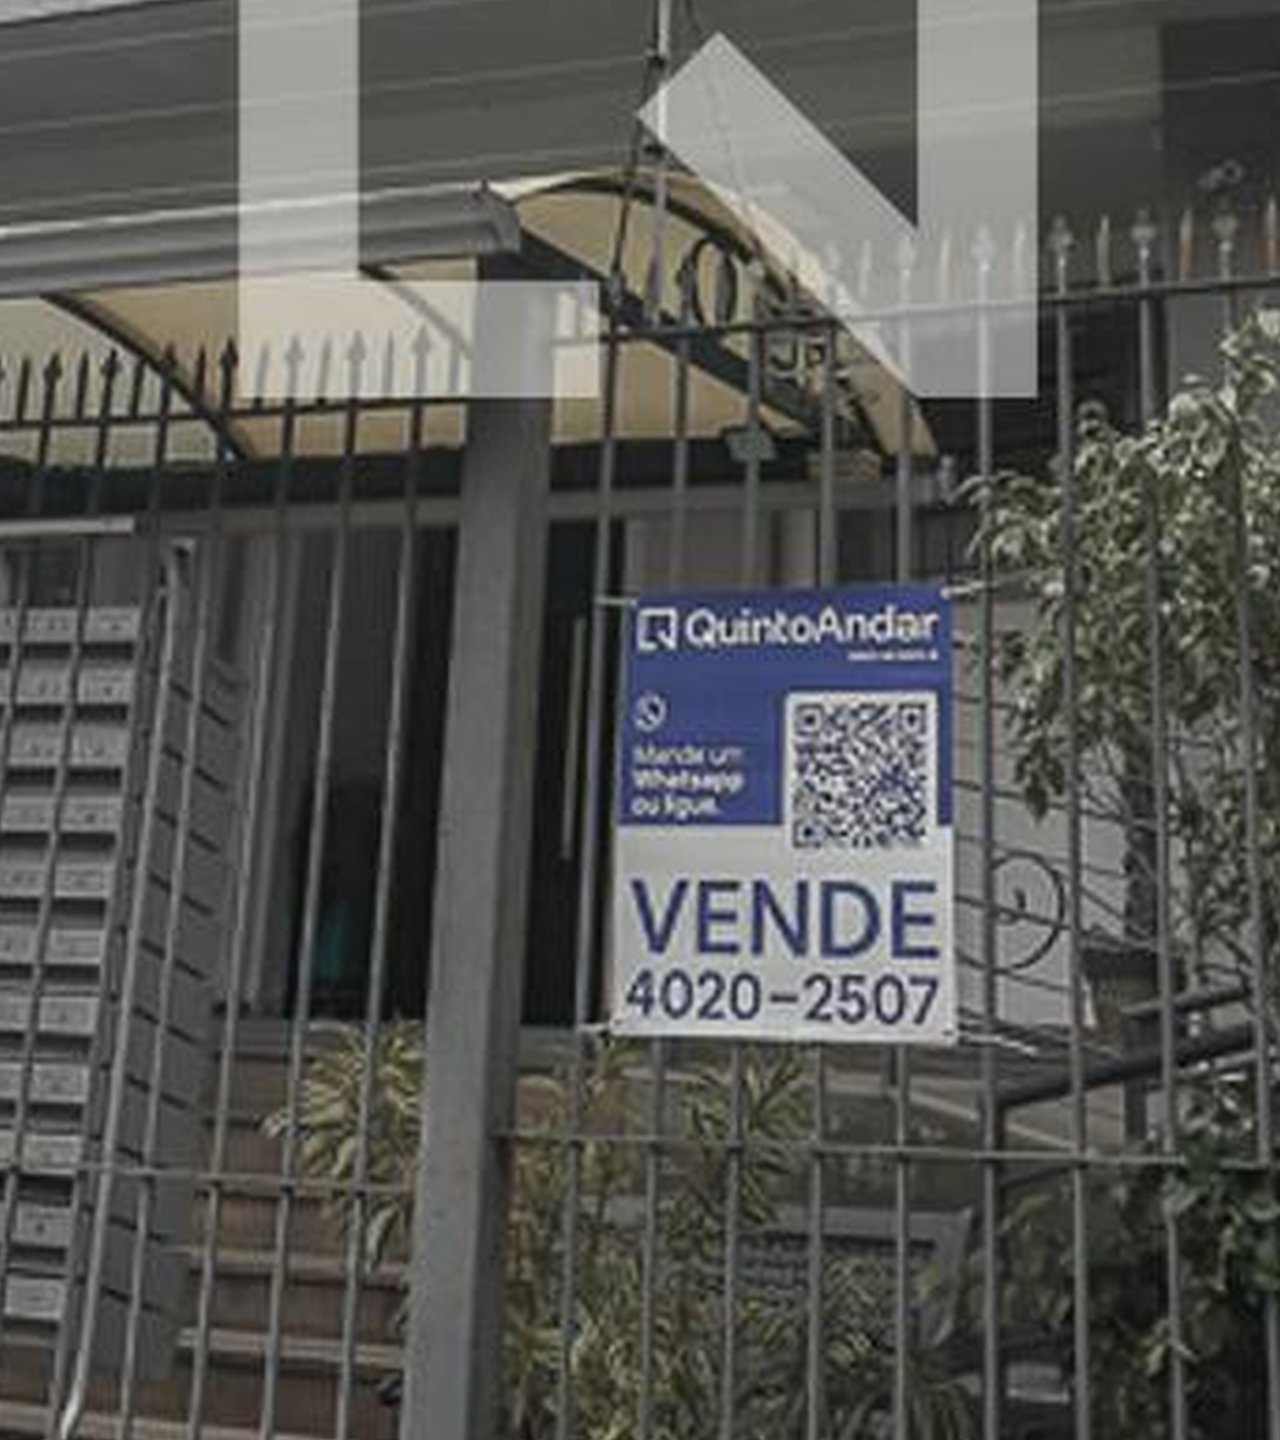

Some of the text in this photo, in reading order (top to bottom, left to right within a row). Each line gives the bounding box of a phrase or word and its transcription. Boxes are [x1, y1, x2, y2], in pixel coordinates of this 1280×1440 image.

[684, 604, 940, 647] QuintoAndar
[631, 797, 661, 816] ou
[629, 878, 941, 959] VENDE
[625, 967, 940, 1024] 4020-2507
